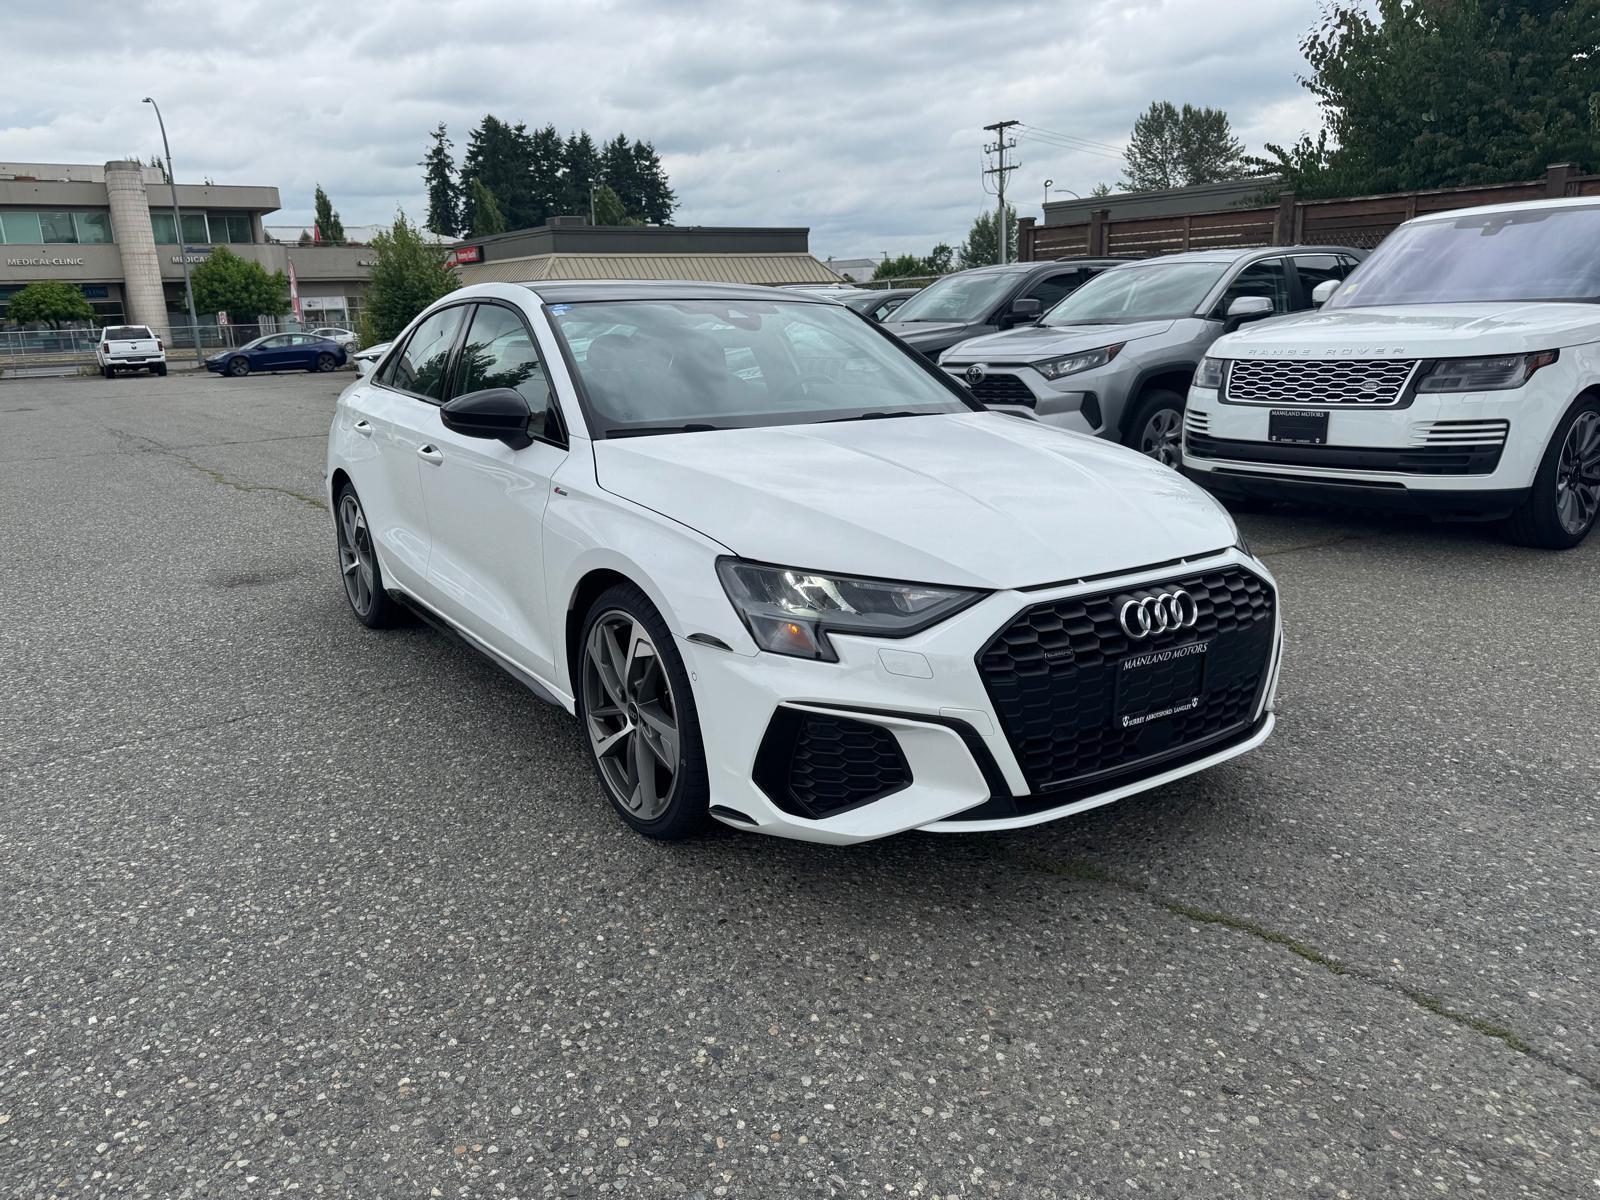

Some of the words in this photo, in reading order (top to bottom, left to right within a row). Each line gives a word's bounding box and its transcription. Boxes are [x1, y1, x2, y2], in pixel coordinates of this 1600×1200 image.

[7, 257, 50, 267] MEDICAL
[52, 257, 84, 265] CLINIC
[172, 256, 207, 264] MEDICA
[1325, 347, 1406, 356] ROVER
[1123, 651, 1171, 670] MAINLAND
[1172, 643, 1208, 659] MOTORS
